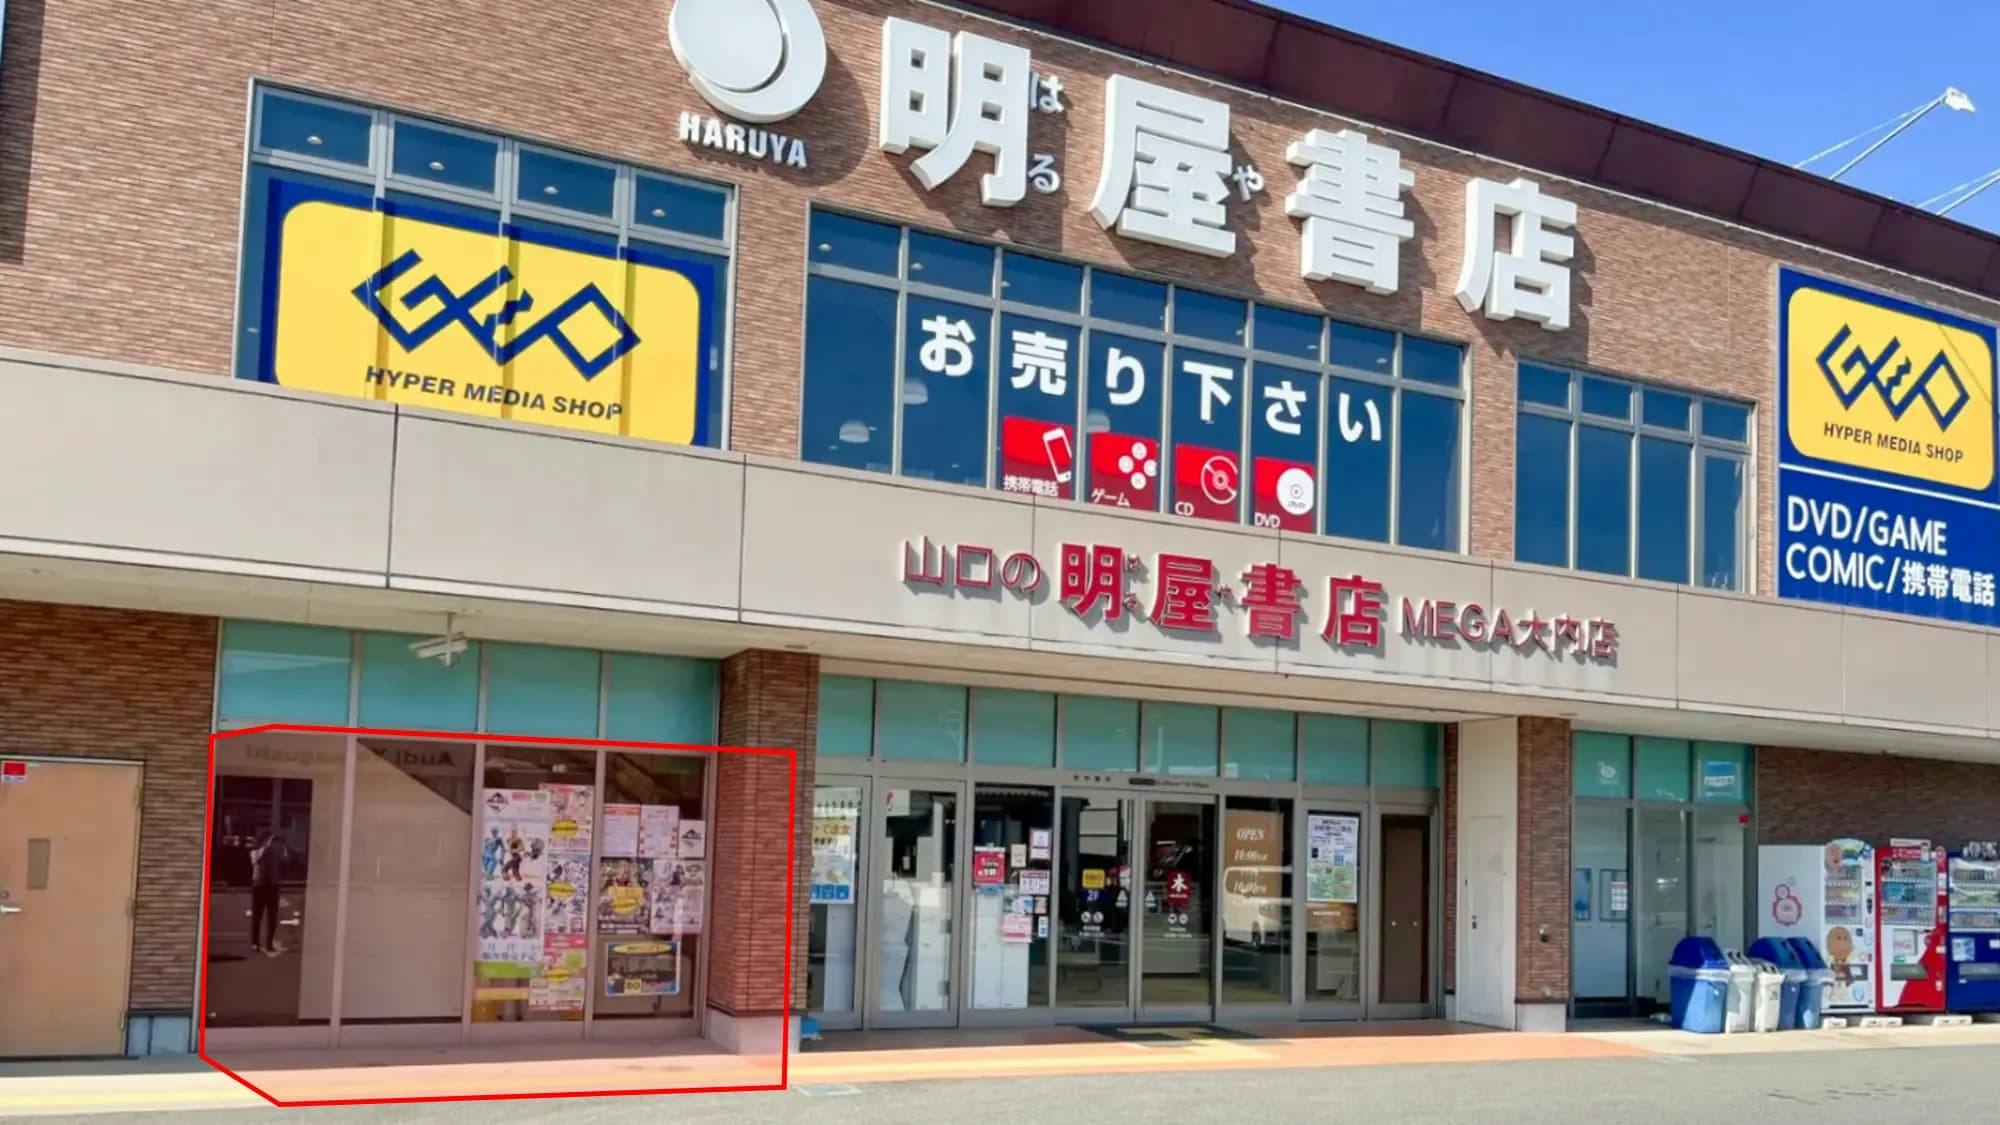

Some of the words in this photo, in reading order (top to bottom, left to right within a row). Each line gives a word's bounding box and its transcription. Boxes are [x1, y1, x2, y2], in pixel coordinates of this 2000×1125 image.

[679, 112, 807, 168] HARUYA
[880, 16, 1577, 331] 明屋書店
[365, 365, 456, 397] HYPER
[463, 382, 546, 411] MEDIA
[553, 395, 624, 420] SHOP
[919, 314, 1383, 443] お売り下さい
[1823, 421, 1872, 446] HYPER
[1876, 433, 1921, 456] MEDIA
[1926, 443, 1964, 464] SHOP
[1003, 474, 1059, 497] 携帯電話
[1091, 488, 1131, 508] ゲーム
[1174, 501, 1195, 516] CD
[1254, 512, 1281, 528] DVD
[1787, 495, 1948, 556] DVD/GAME
[1785, 543, 1996, 607] COMIC/携帯電話
